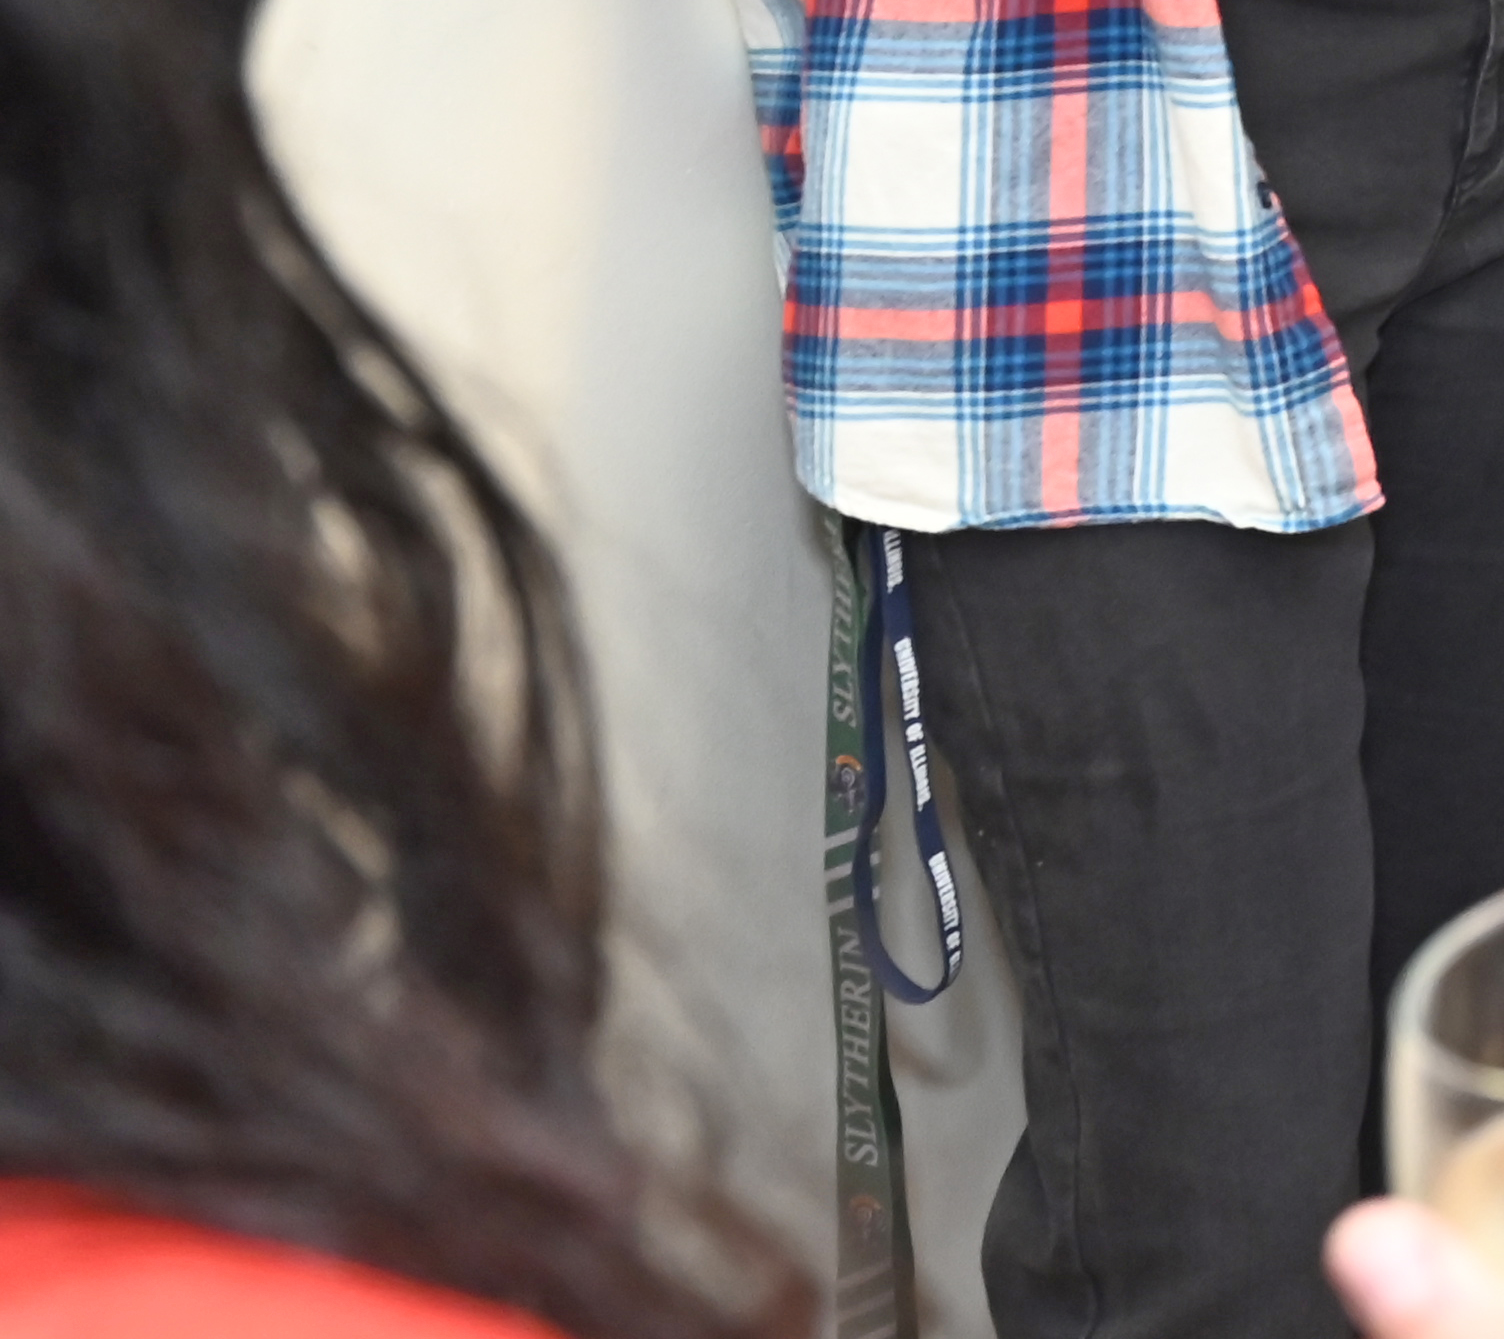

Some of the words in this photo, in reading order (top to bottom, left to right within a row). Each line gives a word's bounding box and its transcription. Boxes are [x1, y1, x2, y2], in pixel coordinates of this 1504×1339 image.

[893, 635, 921, 721] UNIVERSITY
[905, 722, 923, 743] OF
[928, 850, 960, 931] UNIVERSITY
[946, 931, 961, 951] OF
[839, 925, 879, 1169] SLYTHERIN
